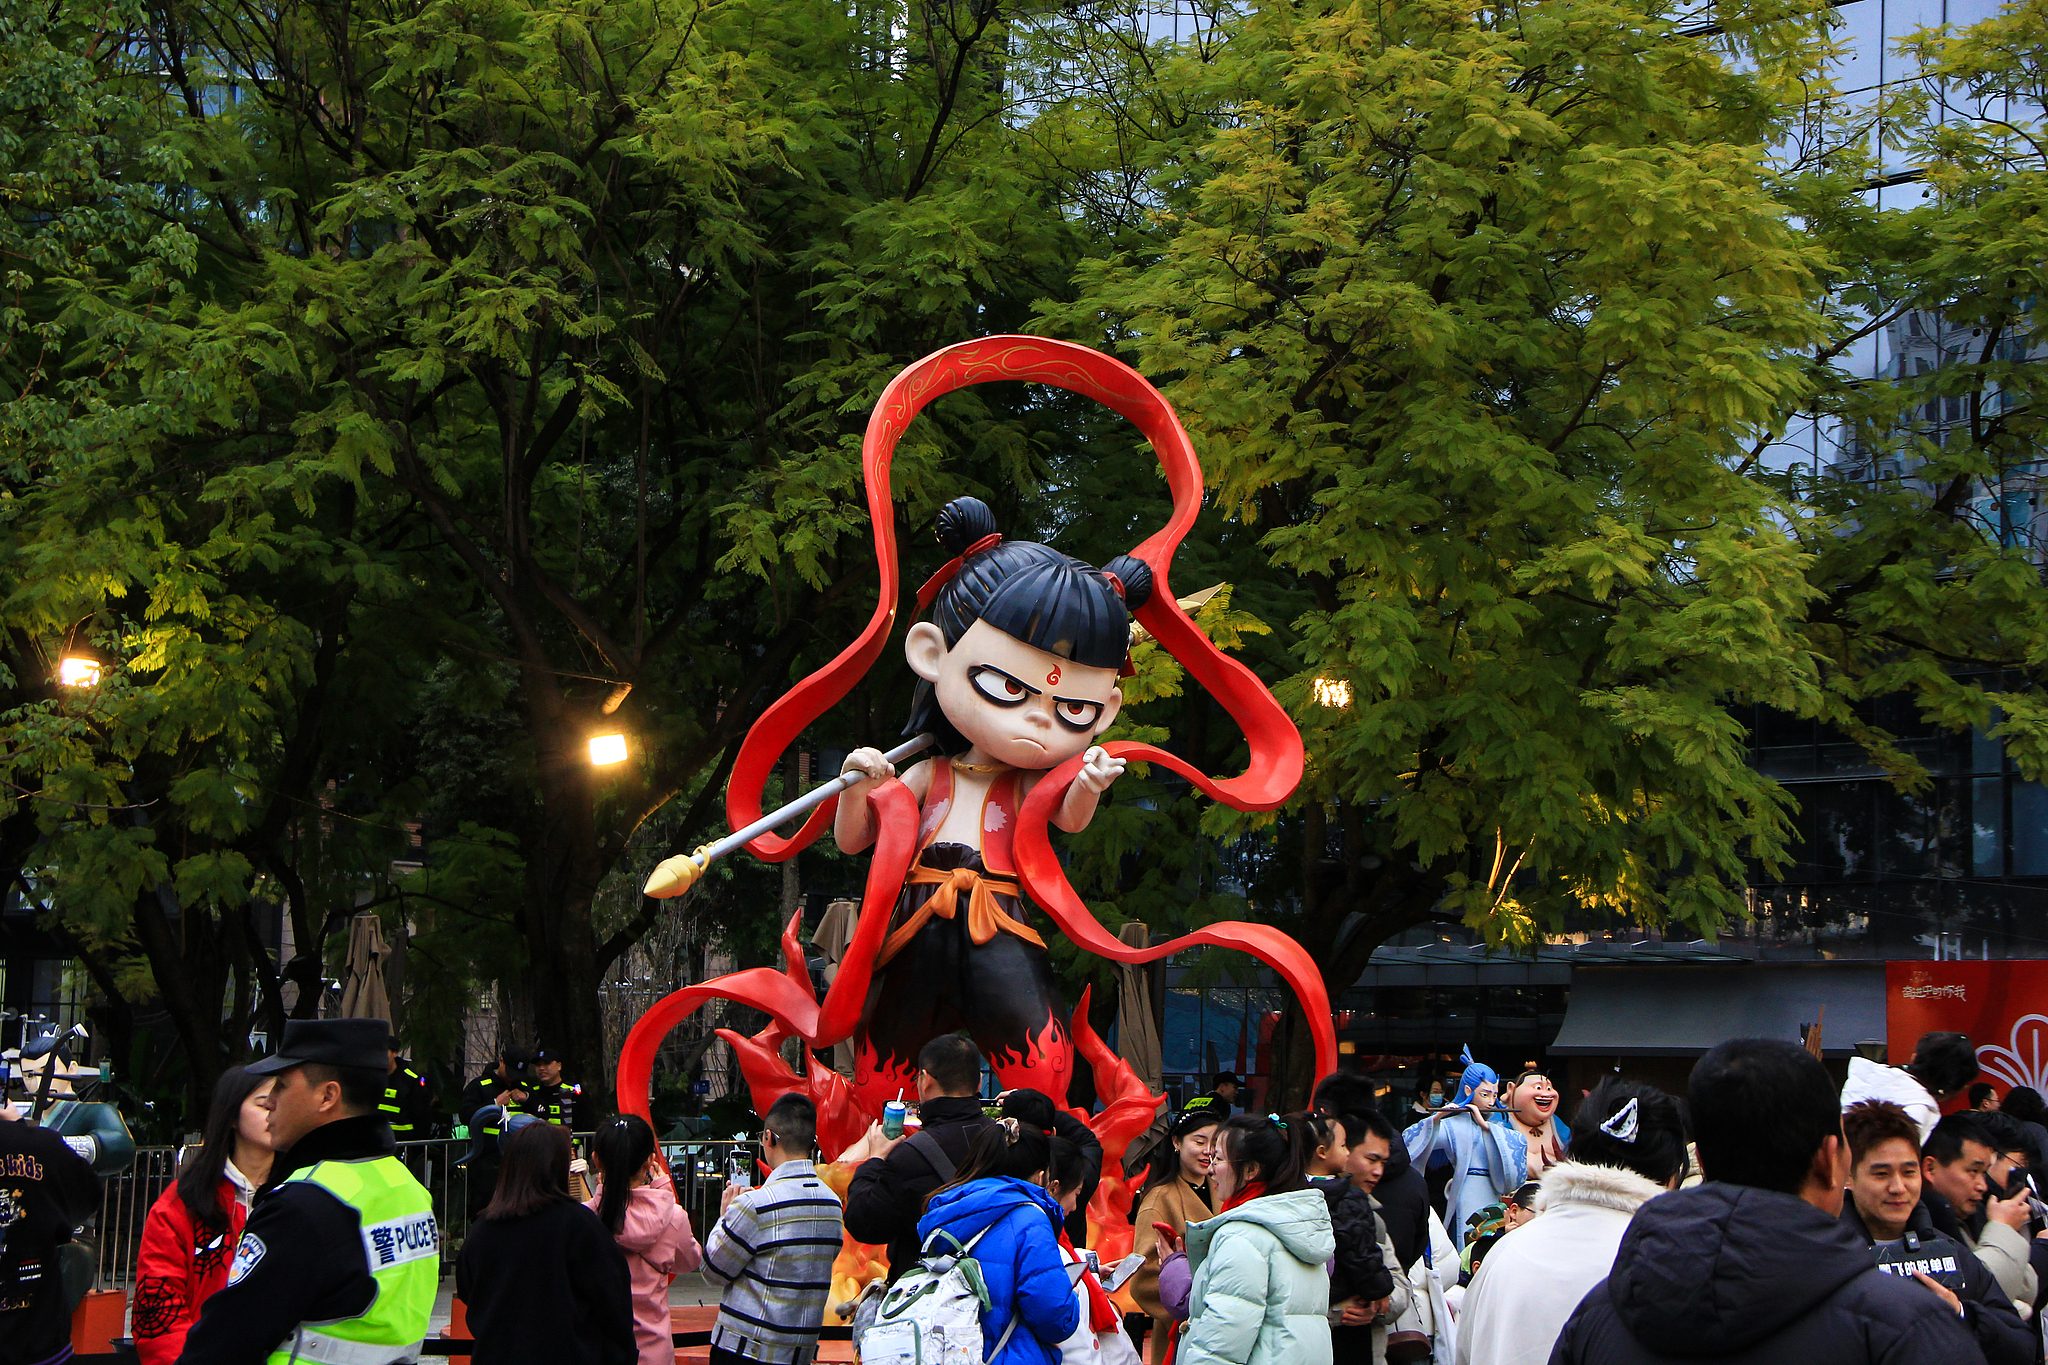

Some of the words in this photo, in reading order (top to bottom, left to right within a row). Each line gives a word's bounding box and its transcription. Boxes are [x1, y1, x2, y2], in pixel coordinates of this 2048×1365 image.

[7, 1154, 43, 1180] kids
[371, 1226, 395, 1265] 警
[395, 1221, 430, 1253] POLICE
